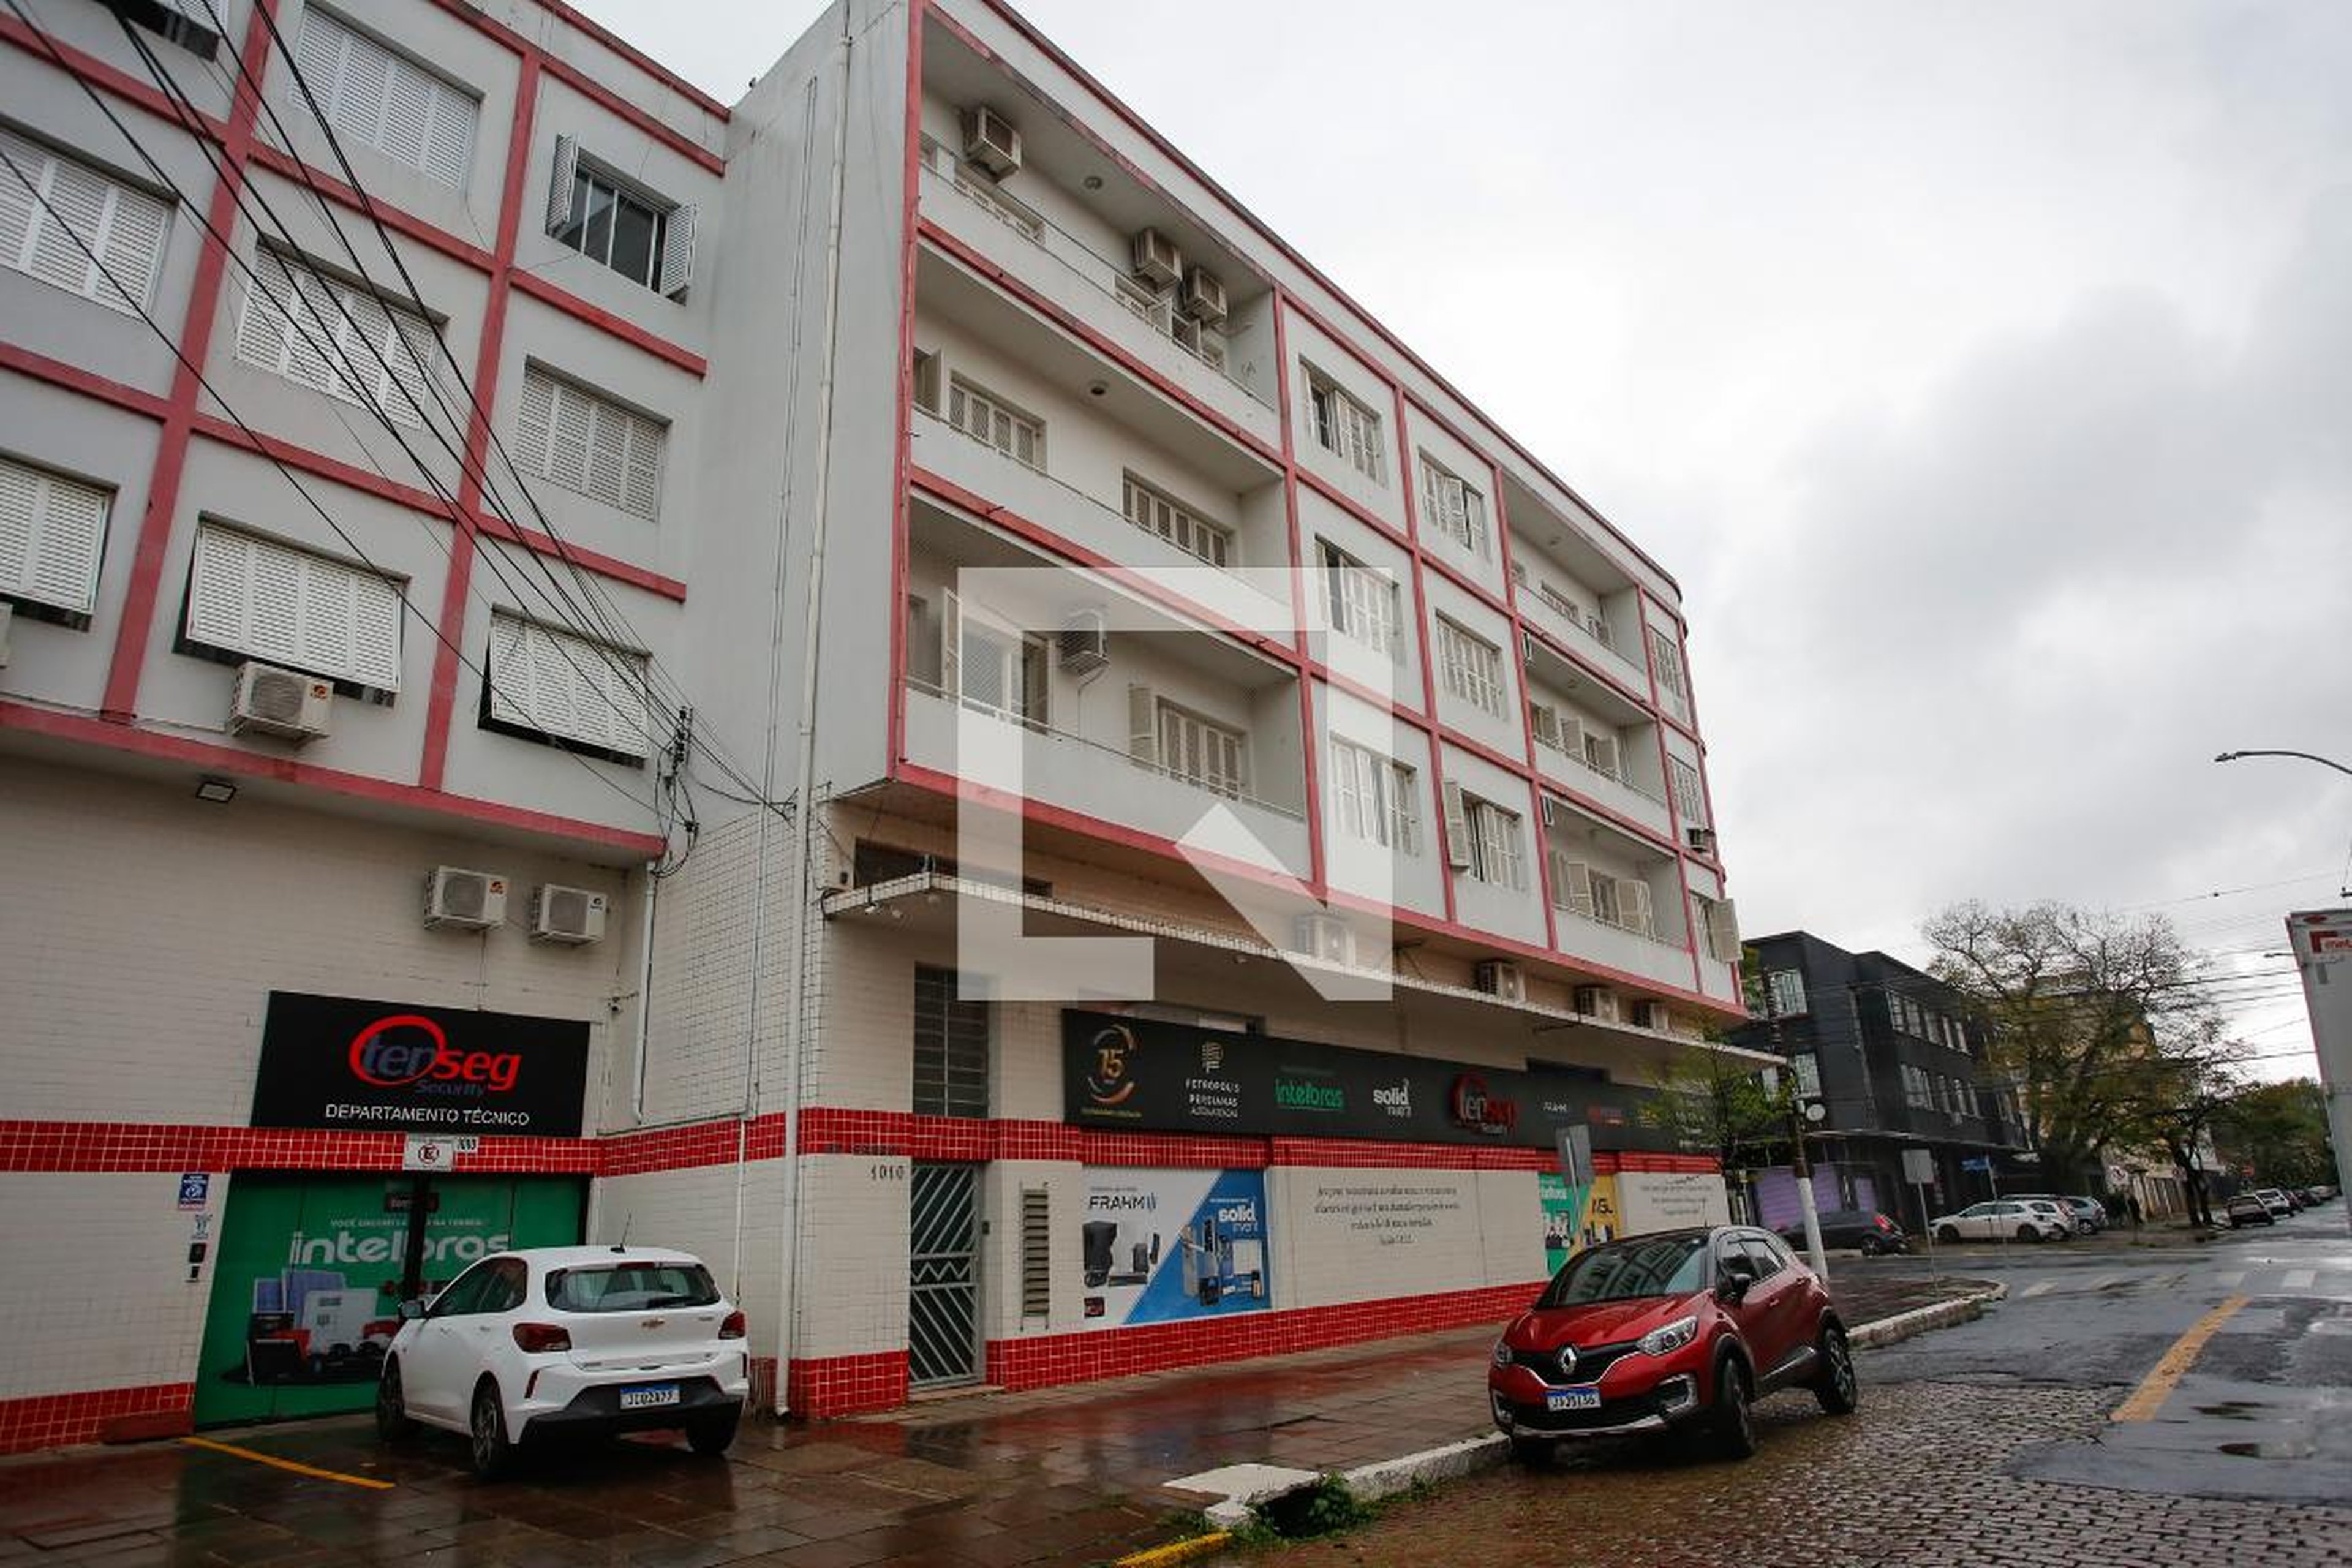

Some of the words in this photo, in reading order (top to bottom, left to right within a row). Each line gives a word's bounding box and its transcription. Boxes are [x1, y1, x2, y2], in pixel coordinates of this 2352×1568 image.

[1373, 1084, 1409, 1106] solid
[325, 1103, 459, 1123] DEPARTAMENTO
[462, 1107, 530, 1126] TÉCNICO
